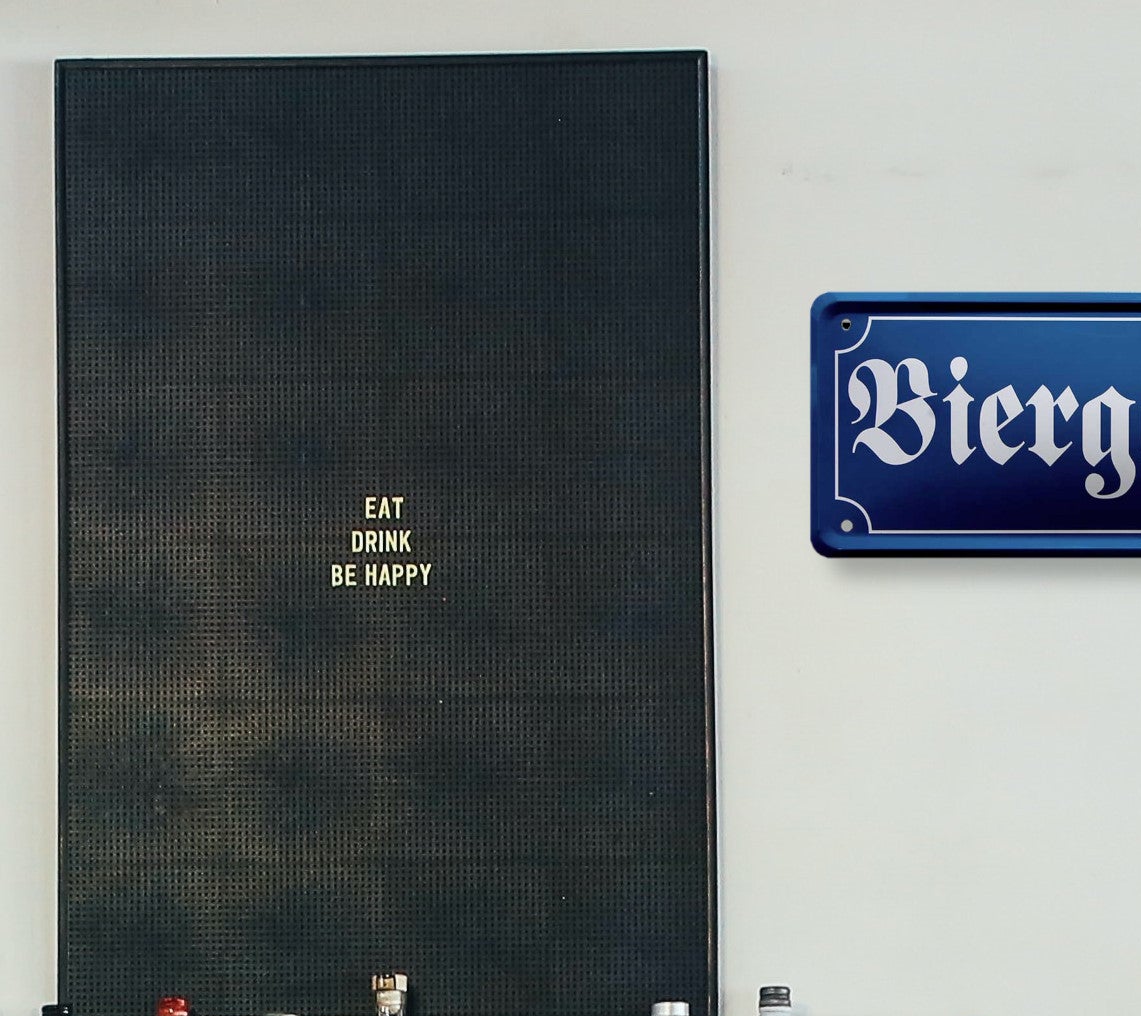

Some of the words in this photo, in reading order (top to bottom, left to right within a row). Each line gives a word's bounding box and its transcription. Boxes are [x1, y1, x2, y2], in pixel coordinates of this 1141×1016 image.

[365, 496, 404, 520] EAT
[351, 529, 412, 554] DRINK
[331, 563, 358, 588] BE
[365, 563, 432, 587] HAPPY
